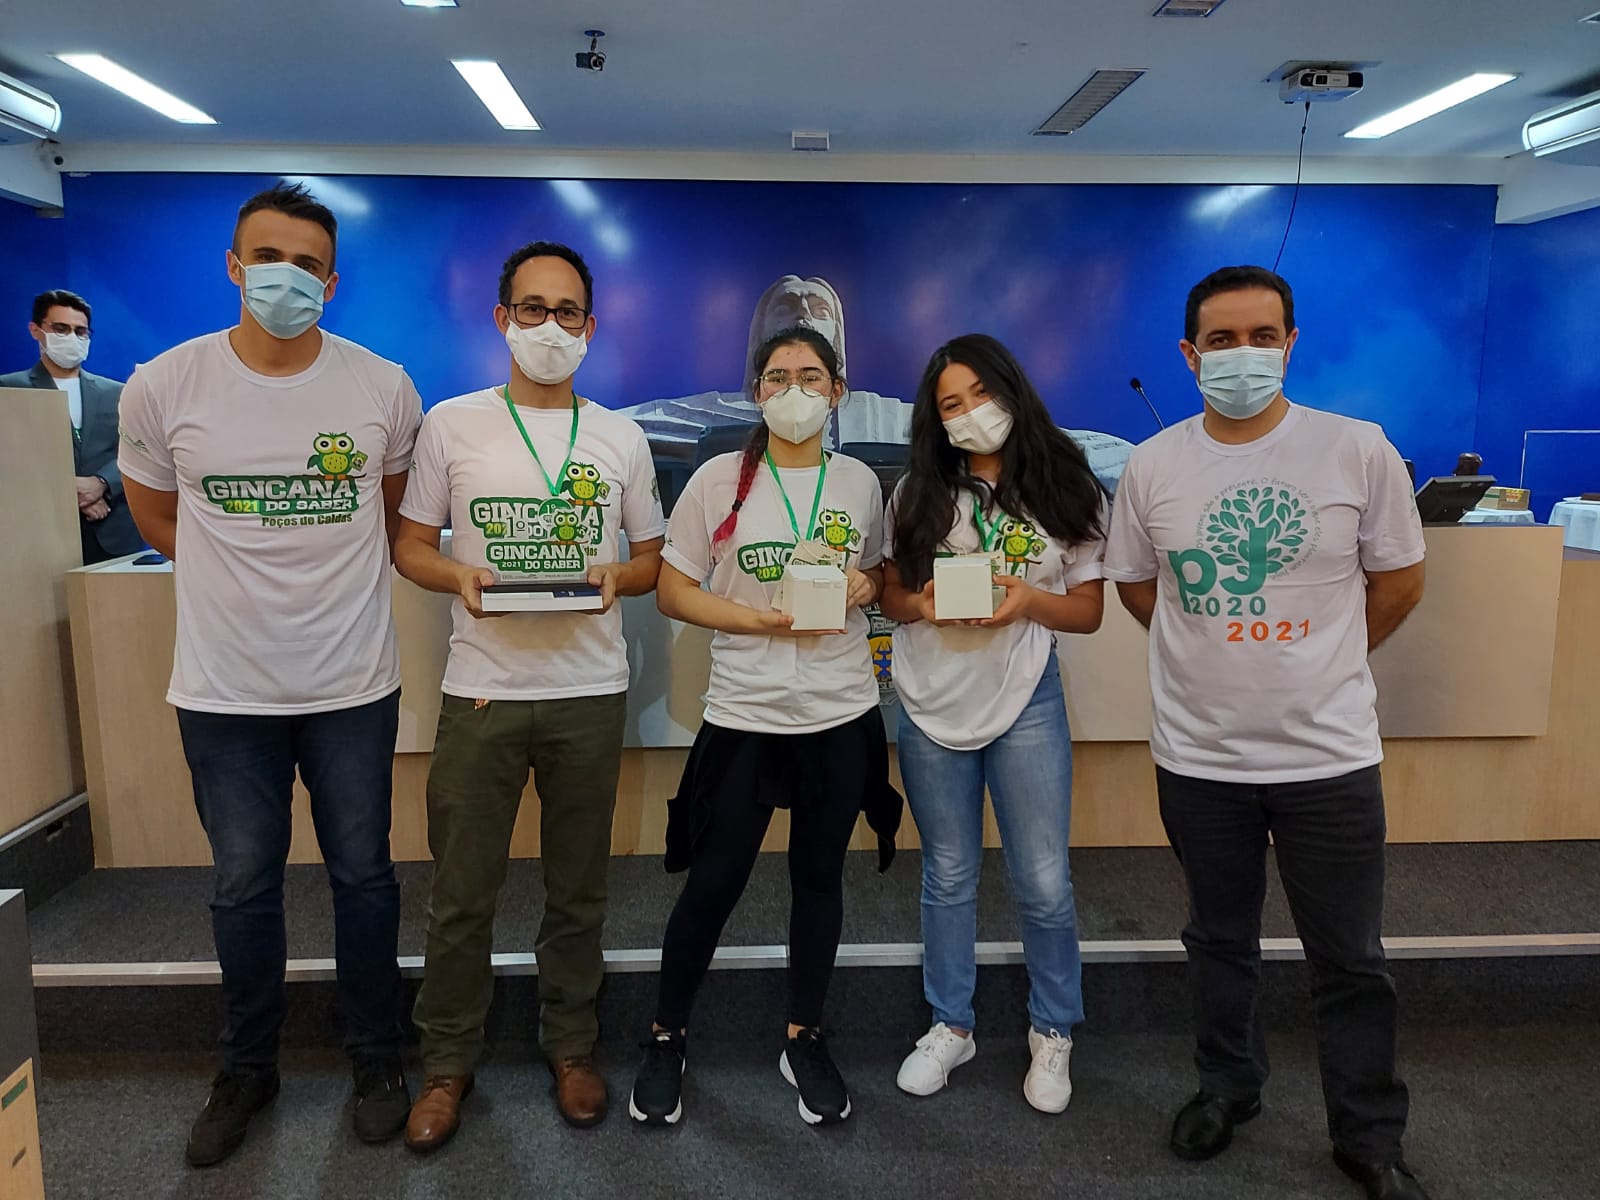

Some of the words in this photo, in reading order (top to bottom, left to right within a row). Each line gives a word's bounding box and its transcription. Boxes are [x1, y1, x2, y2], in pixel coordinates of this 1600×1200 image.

[207, 479, 355, 500] GINCANA
[225, 500, 258, 513] 2021
[265, 500, 290, 512] DO
[295, 498, 353, 511] SABER
[262, 515, 298, 528] Poços
[317, 513, 353, 525] Caldas
[490, 543, 580, 560] GINCANA
[501, 560, 521, 568] 2021
[524, 559, 541, 570] DO
[543, 558, 581, 570] SABER
[1189, 595, 1267, 617] 2020
[1226, 618, 1310, 642] 2021
